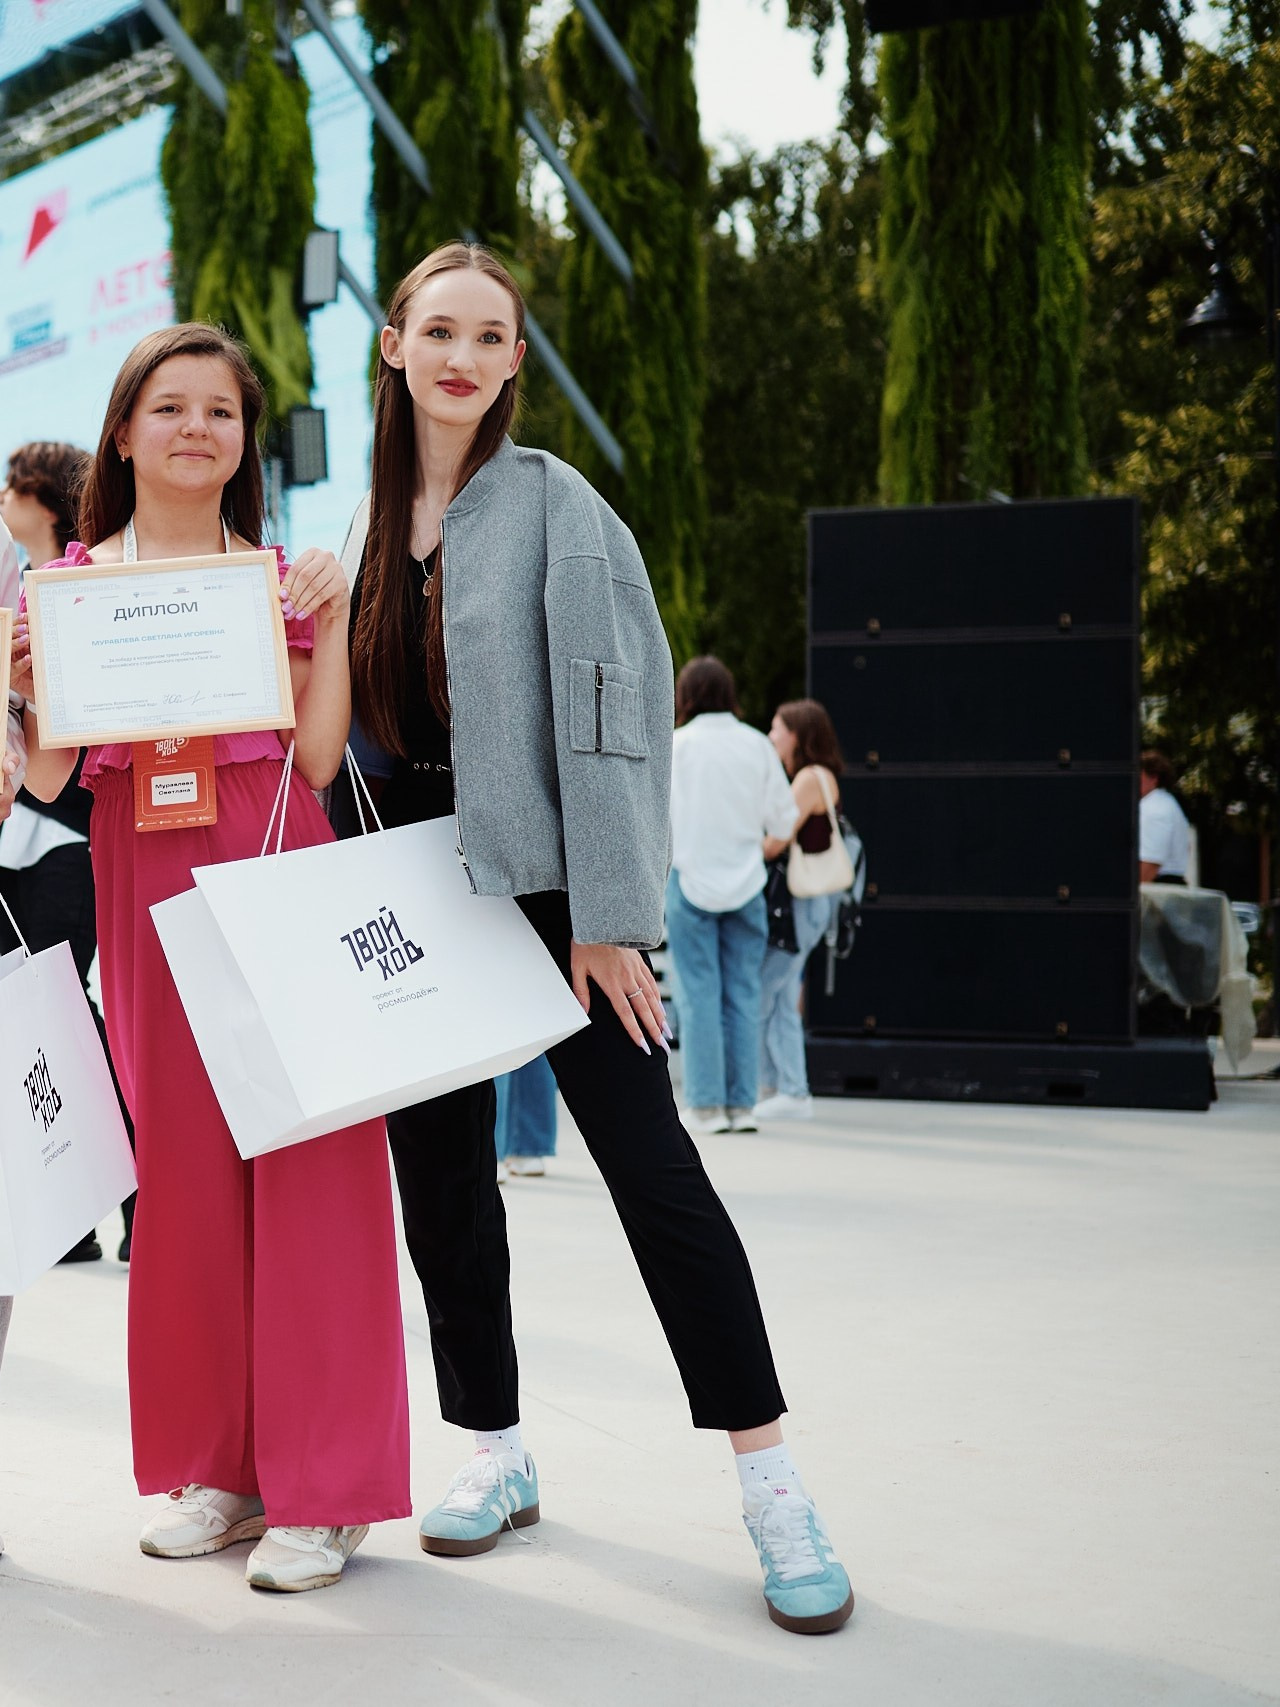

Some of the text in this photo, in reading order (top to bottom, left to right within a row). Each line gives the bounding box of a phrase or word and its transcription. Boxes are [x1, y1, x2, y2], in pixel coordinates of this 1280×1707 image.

[113, 601, 199, 622] ДИПЛОМ
[92, 629, 226, 646] МУРАВЛЕВА СВЕТЛАНА ИГОРЕВНА
[155, 781, 194, 790] Муравлева
[340, 906, 404, 972] ТВОЙ
[376, 940, 424, 981] ХОД
[372, 990, 394, 1000] проект
[377, 986, 439, 1014] росмолодёжь
[24, 1047, 52, 1122] ТВОЙ
[40, 1087, 62, 1133] ХОД
